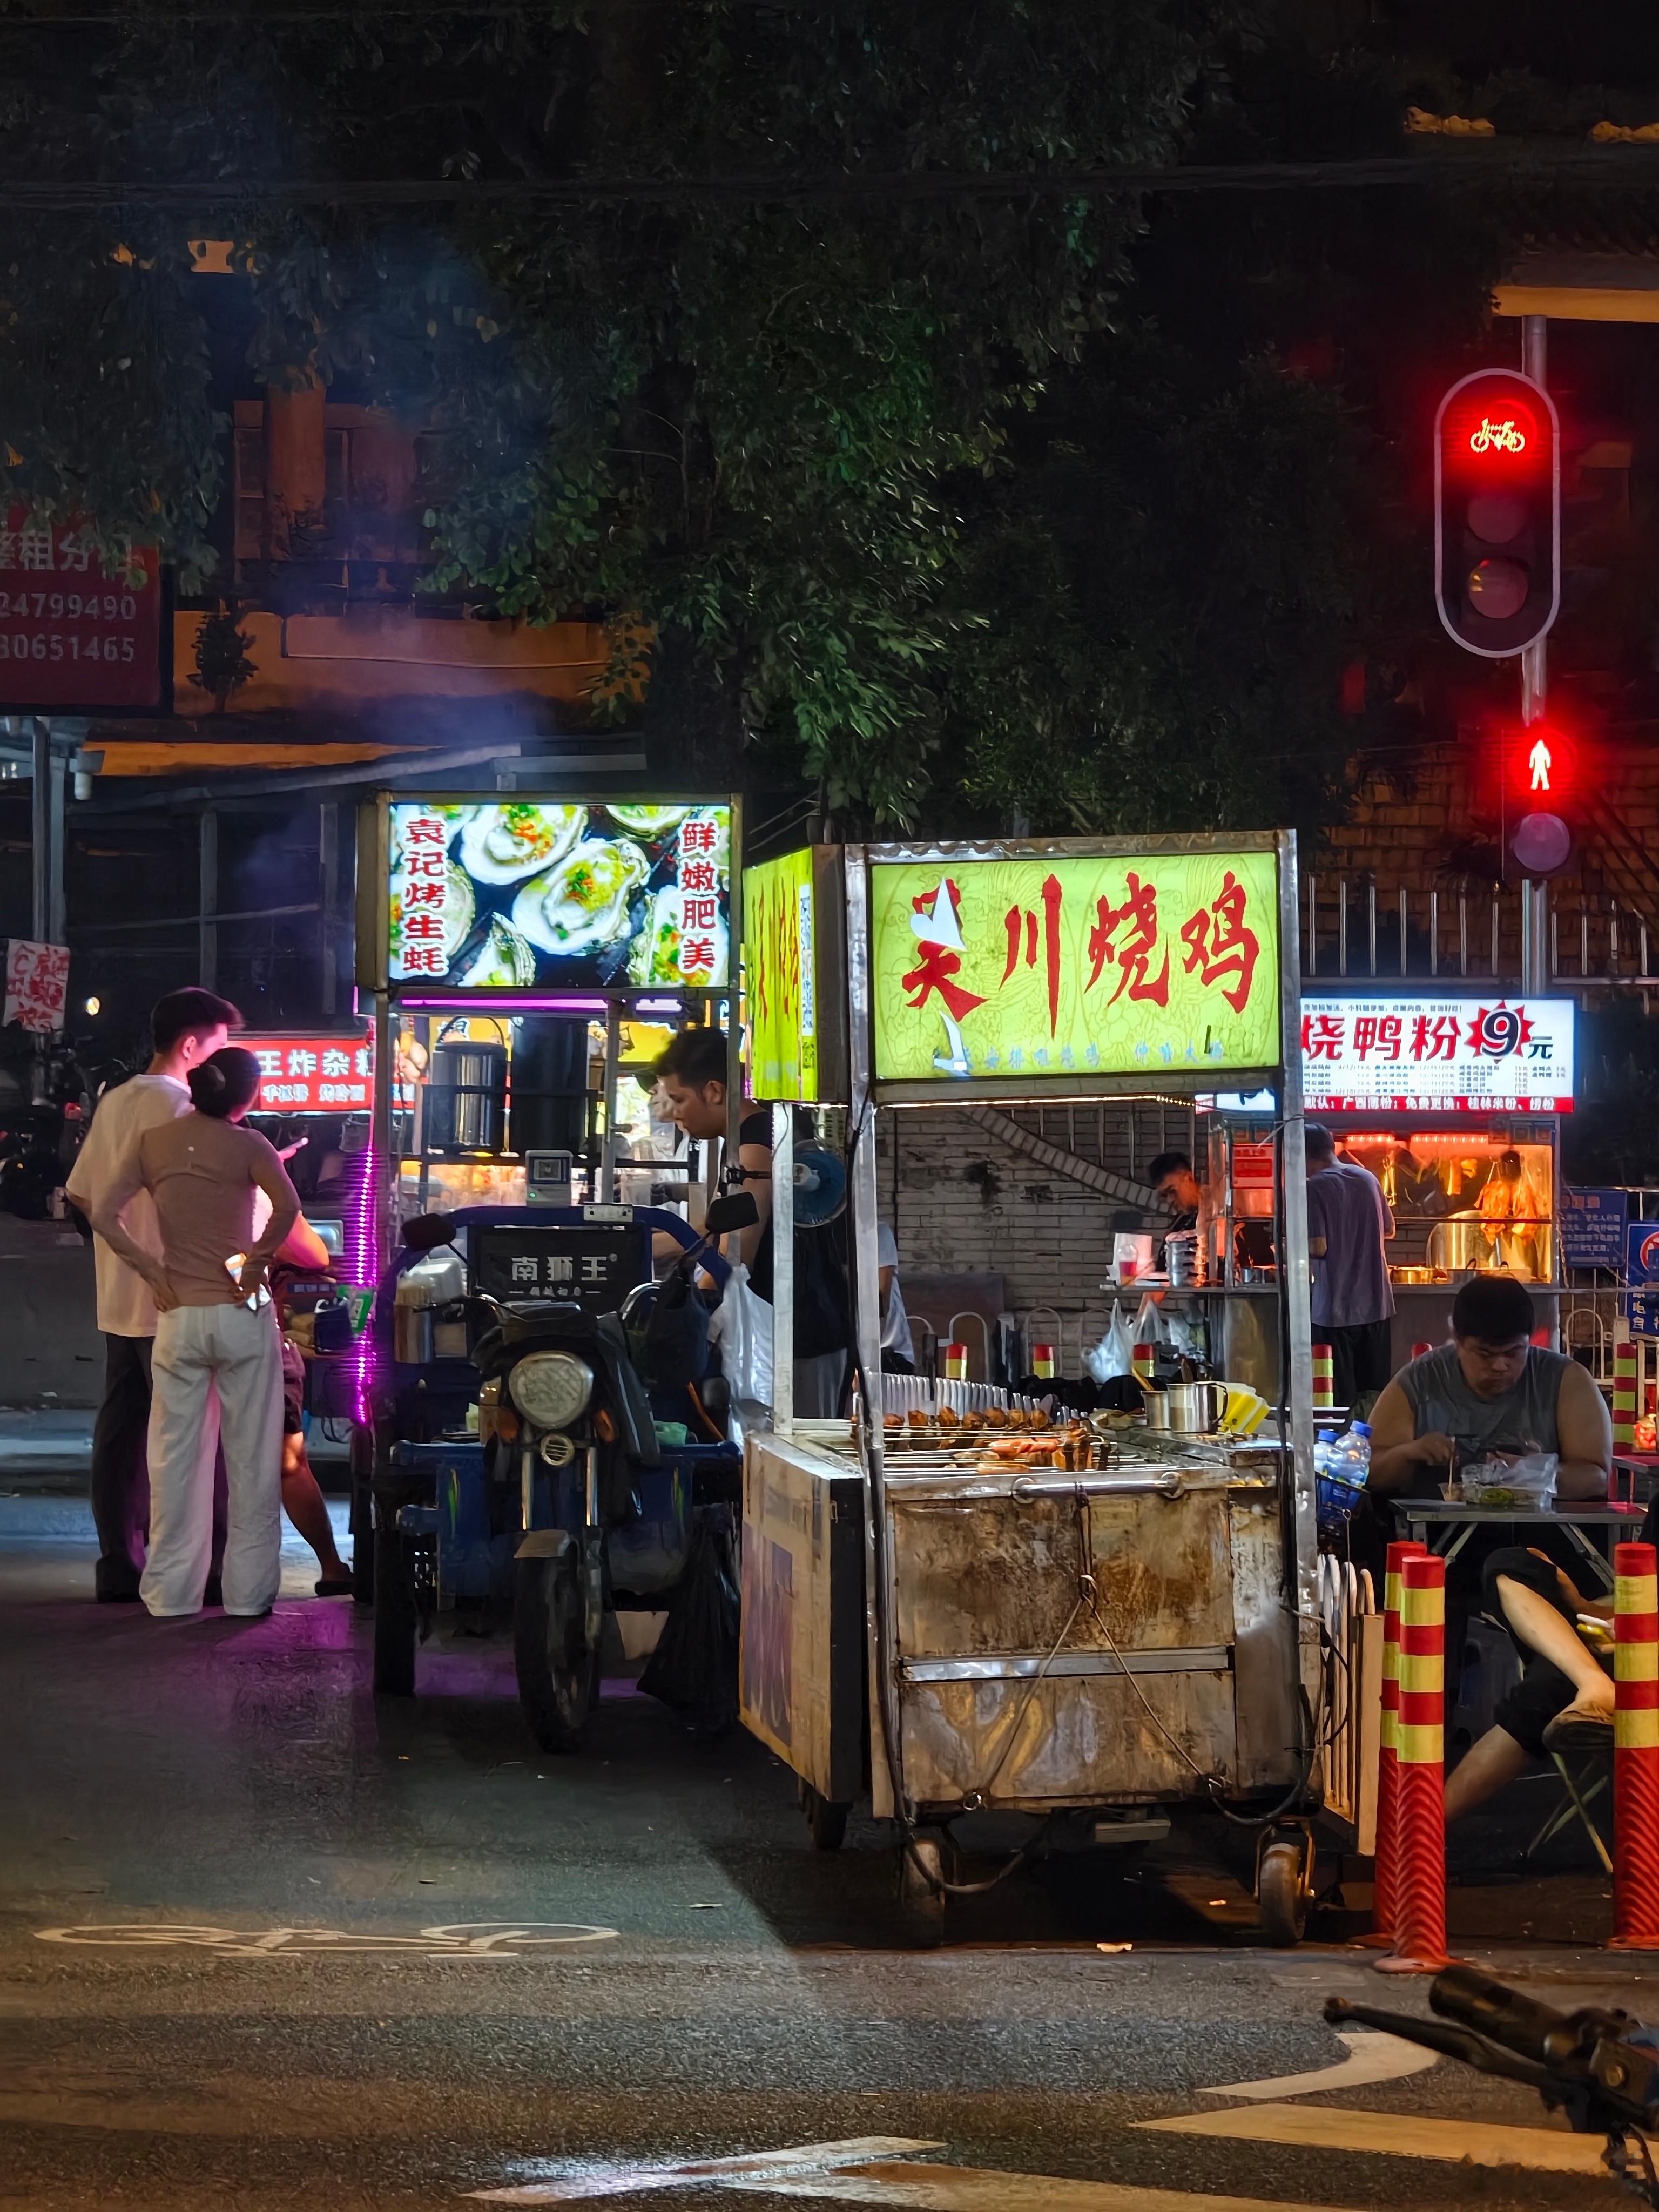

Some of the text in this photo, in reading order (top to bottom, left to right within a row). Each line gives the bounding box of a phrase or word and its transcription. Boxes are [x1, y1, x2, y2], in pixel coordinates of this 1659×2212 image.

[402, 818, 446, 973] 袁记烤生蚝
[680, 821, 717, 970] 鲜嫩肥美
[1300, 1014, 1462, 1062] 烧鸭粉
